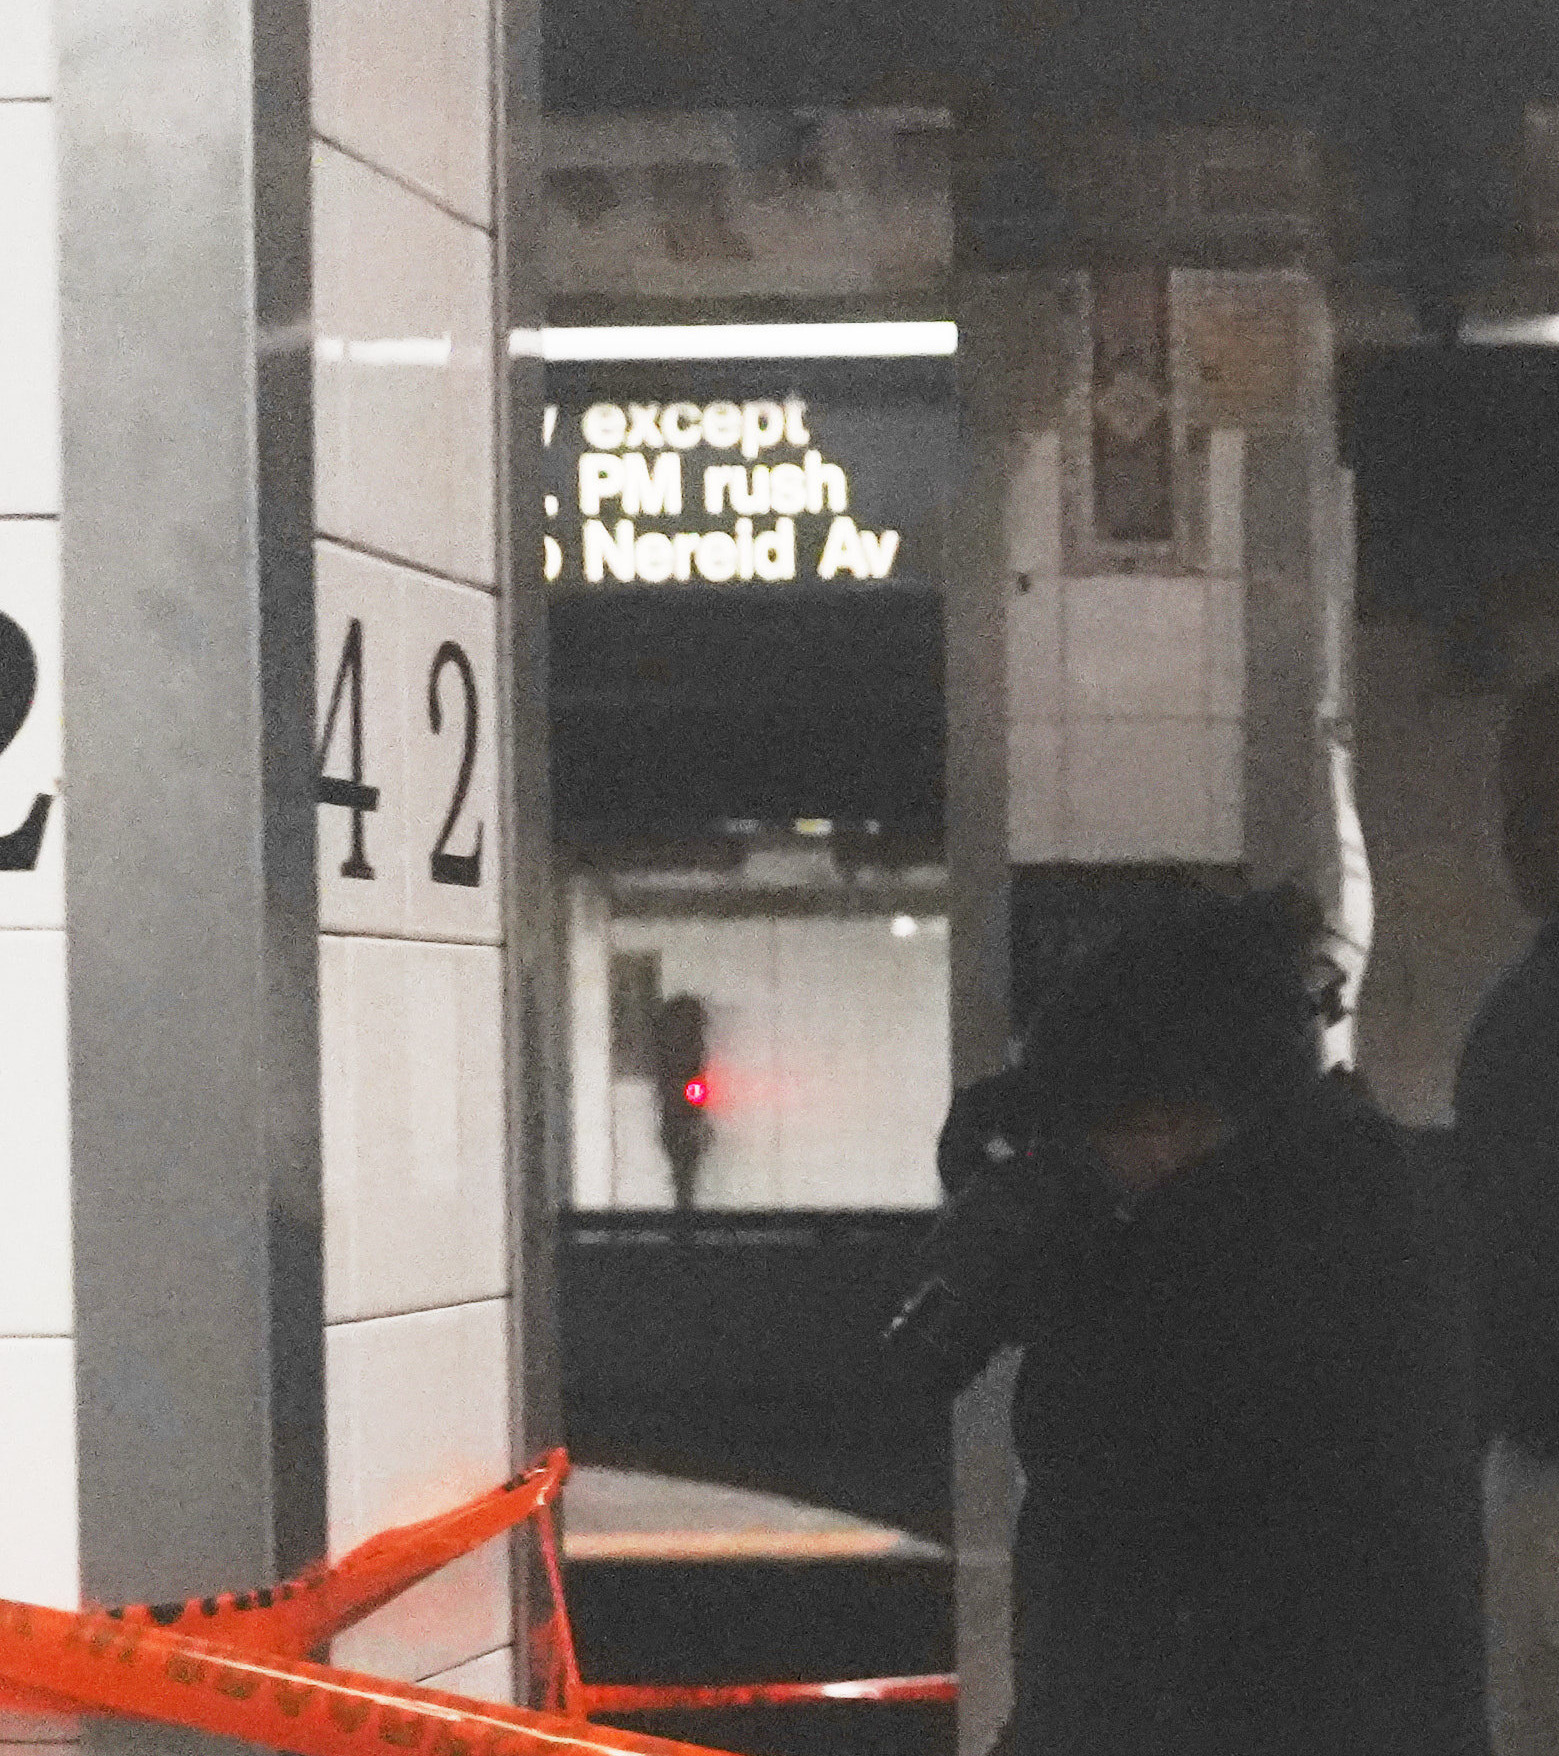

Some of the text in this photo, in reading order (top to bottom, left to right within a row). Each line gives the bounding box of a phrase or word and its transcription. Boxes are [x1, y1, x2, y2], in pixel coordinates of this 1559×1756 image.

[581, 393, 810, 459] except
[578, 449, 847, 515] PM rush
[582, 516, 797, 582] Nereid
[817, 516, 900, 580] Av
[314, 617, 483, 887] 42
